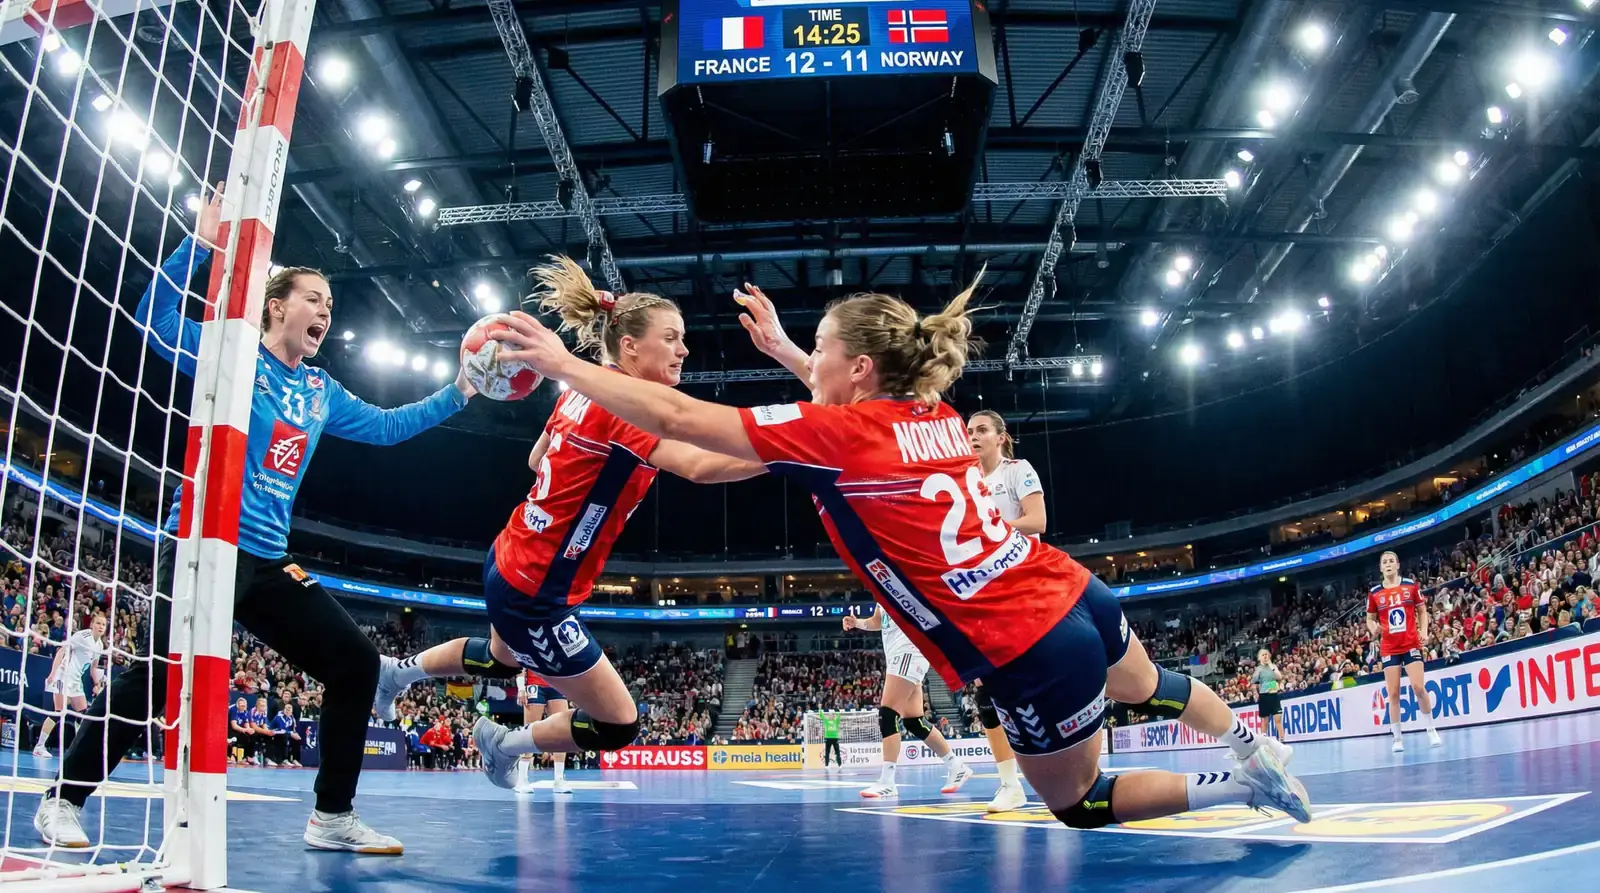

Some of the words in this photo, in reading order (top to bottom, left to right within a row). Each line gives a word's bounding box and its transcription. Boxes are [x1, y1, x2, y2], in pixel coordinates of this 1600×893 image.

[808, 9, 842, 22] TIME
[793, 23, 861, 46] 14:25
[694, 57, 771, 76] FRANCE
[785, 52, 816, 74] 12
[840, 50, 868, 72] 11
[880, 51, 964, 68] NORWAY
[892, 416, 972, 464] NORWAY
[810, 606, 824, 617] 12
[848, 605, 861, 617] 11
[1147, 724, 1170, 746] SPORT
[620, 750, 704, 766] STRAUSS
